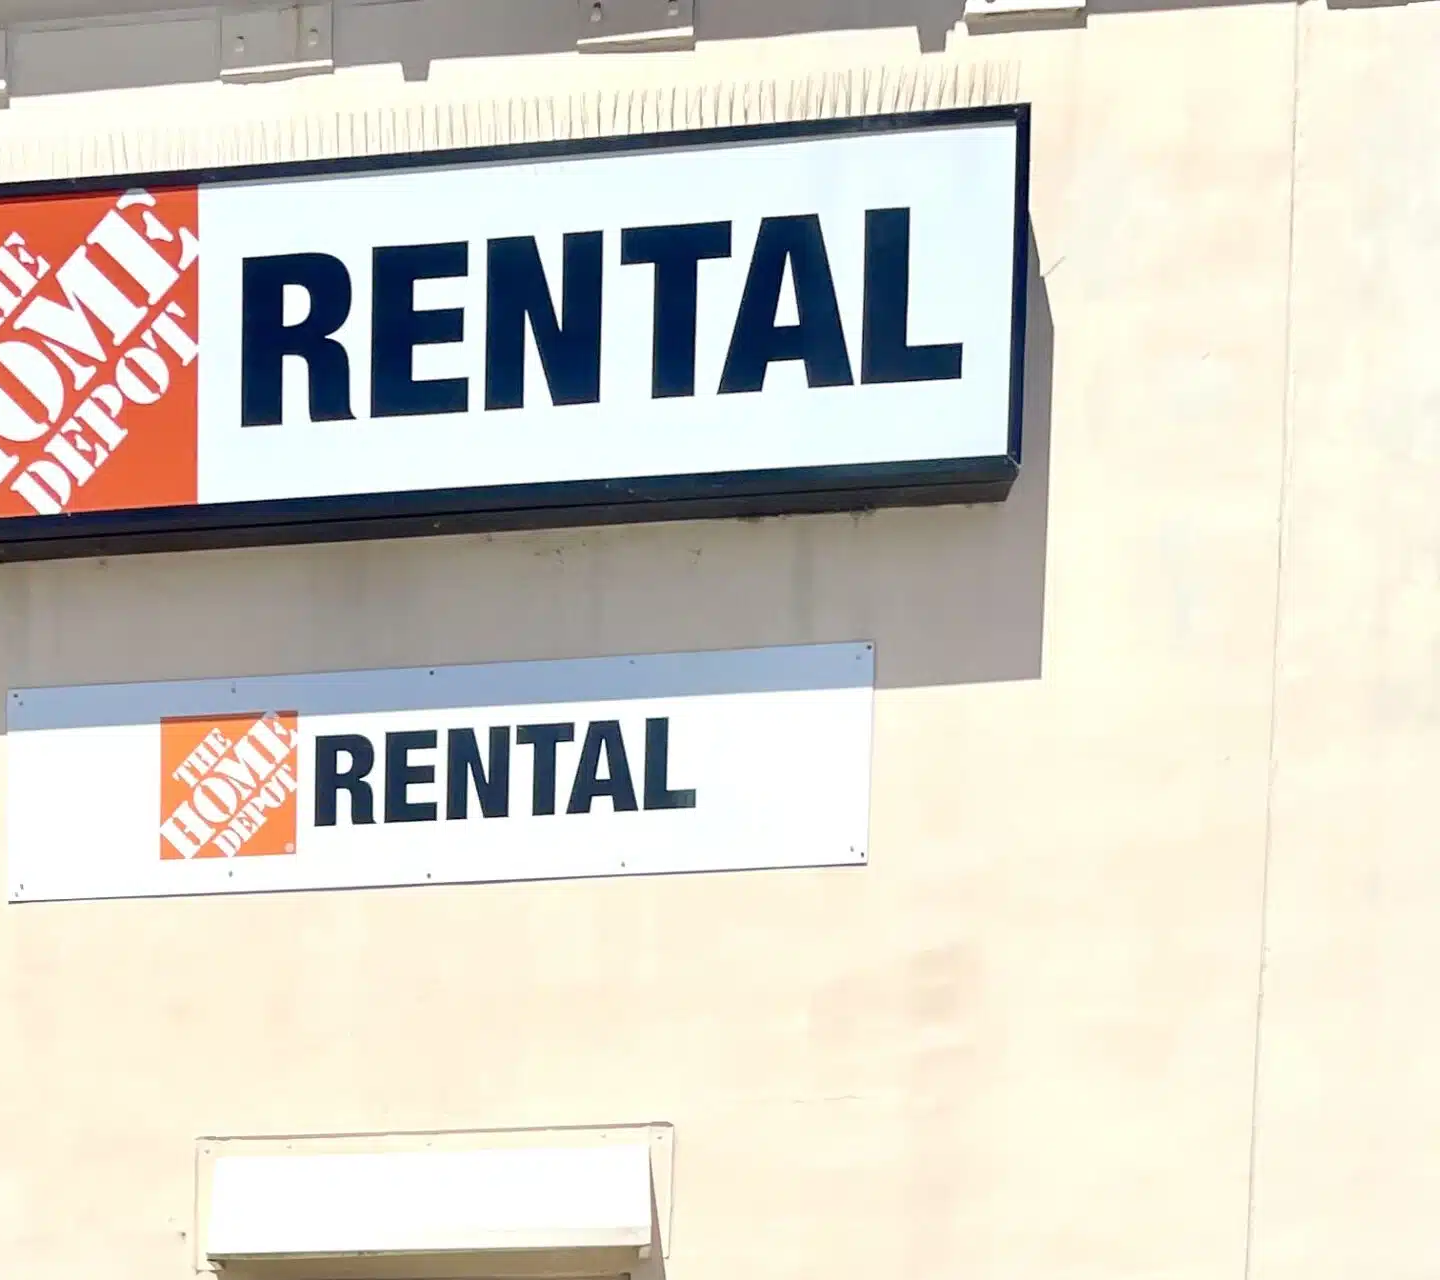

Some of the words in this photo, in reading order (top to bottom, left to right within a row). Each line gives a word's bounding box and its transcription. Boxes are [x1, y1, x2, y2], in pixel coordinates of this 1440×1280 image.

[241, 206, 963, 427] RENTAL
[10, 300, 198, 516] DEPOT
[161, 710, 298, 859] HOME
[172, 727, 233, 788] THE
[212, 764, 297, 858] DEPOT
[314, 716, 695, 827] RENTAL
